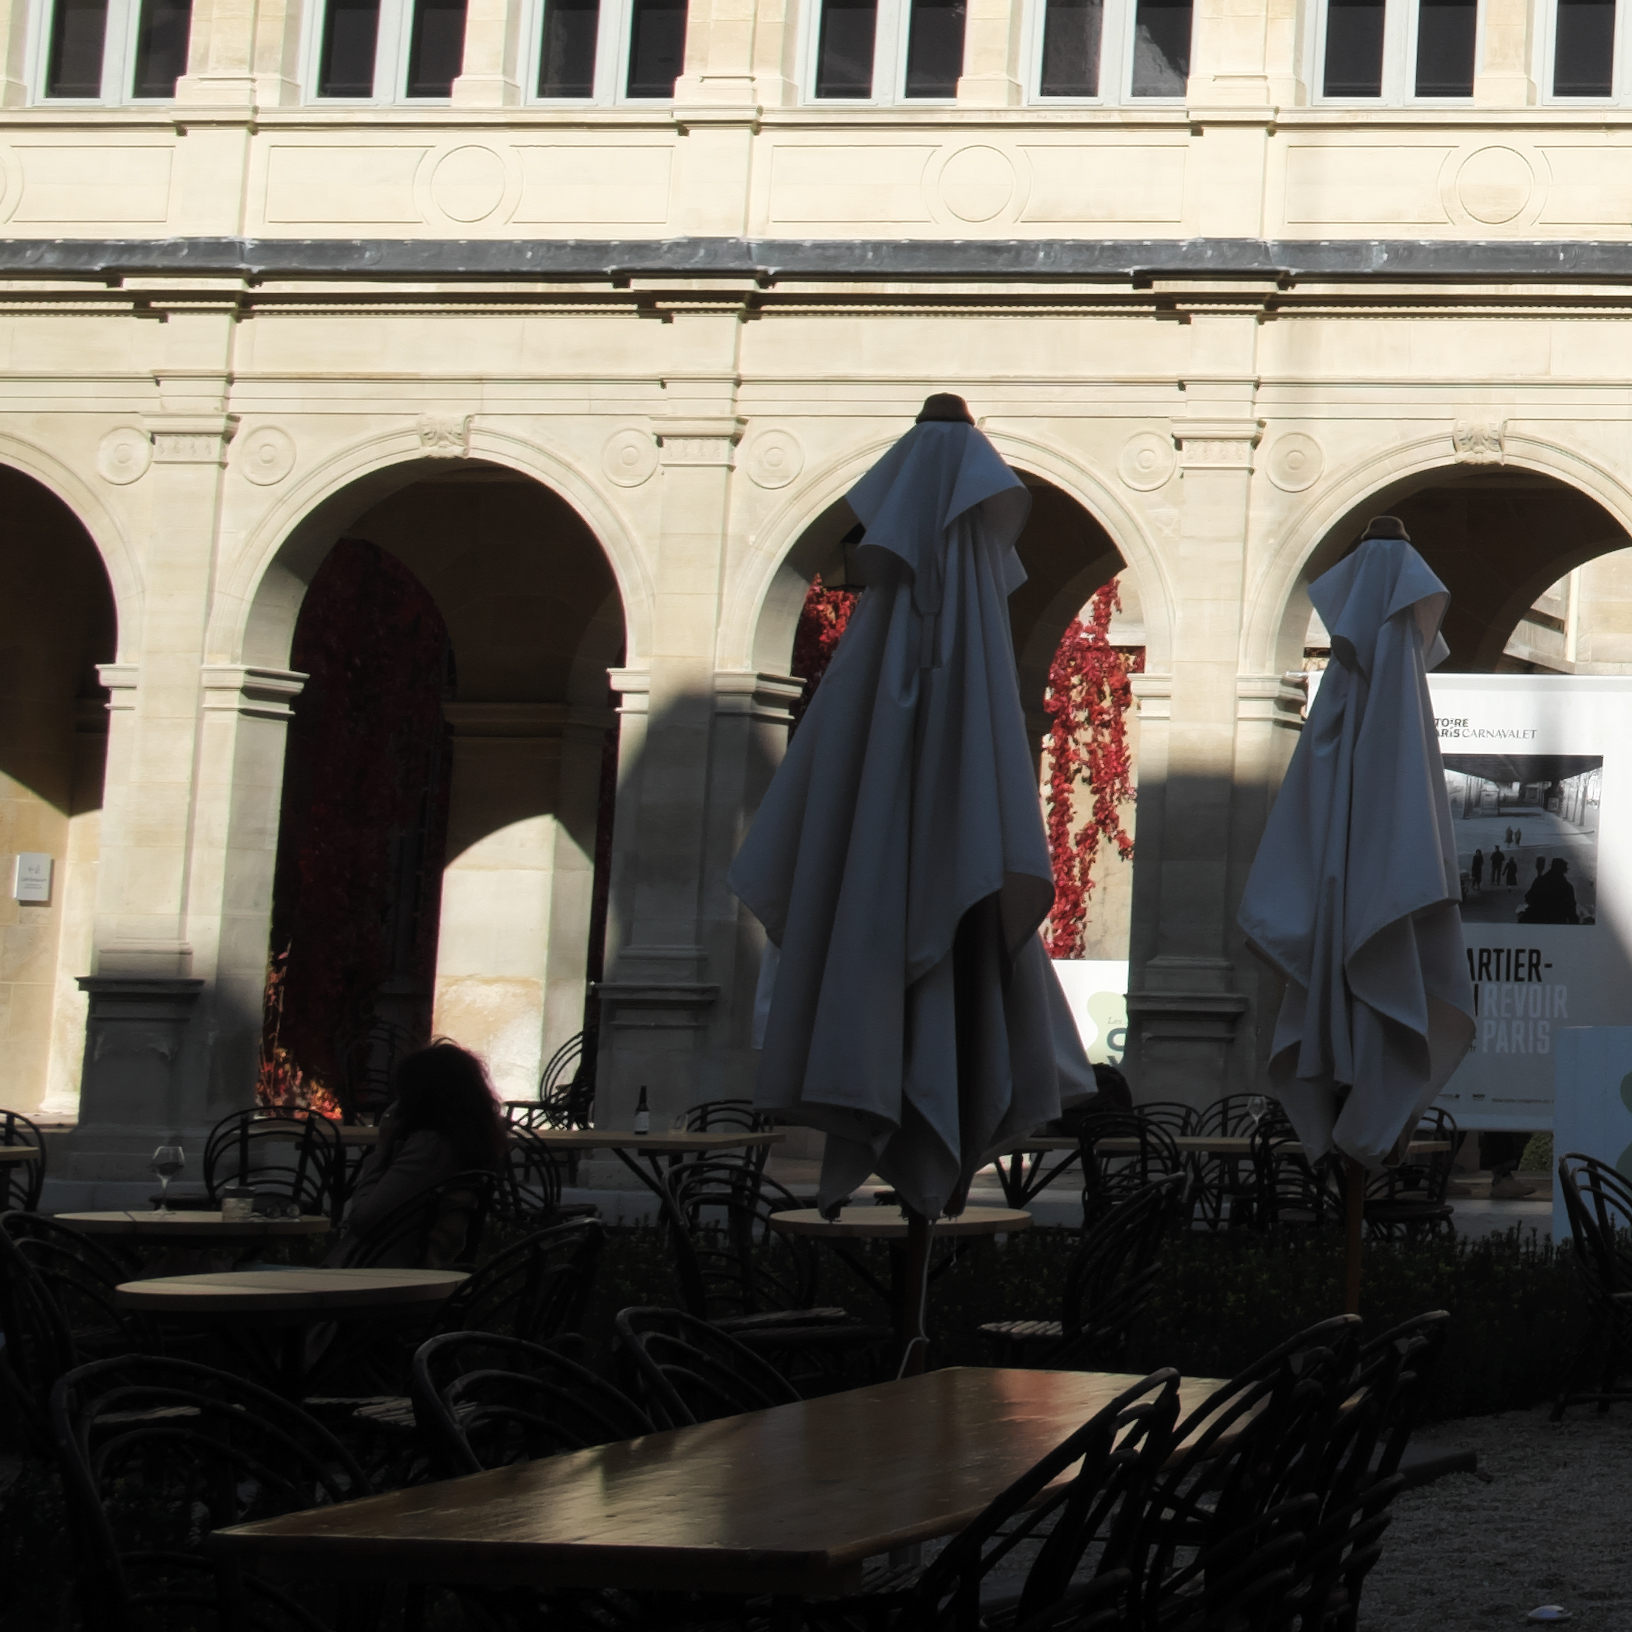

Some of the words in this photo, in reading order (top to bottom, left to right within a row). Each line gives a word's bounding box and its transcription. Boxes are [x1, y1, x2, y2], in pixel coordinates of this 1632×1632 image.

[1462, 729, 1537, 739] CARNAVALET
[1467, 948, 1553, 983] RTIER-
[1483, 984, 1569, 1019] REVOIR
[1482, 1020, 1550, 1054] PARIS
